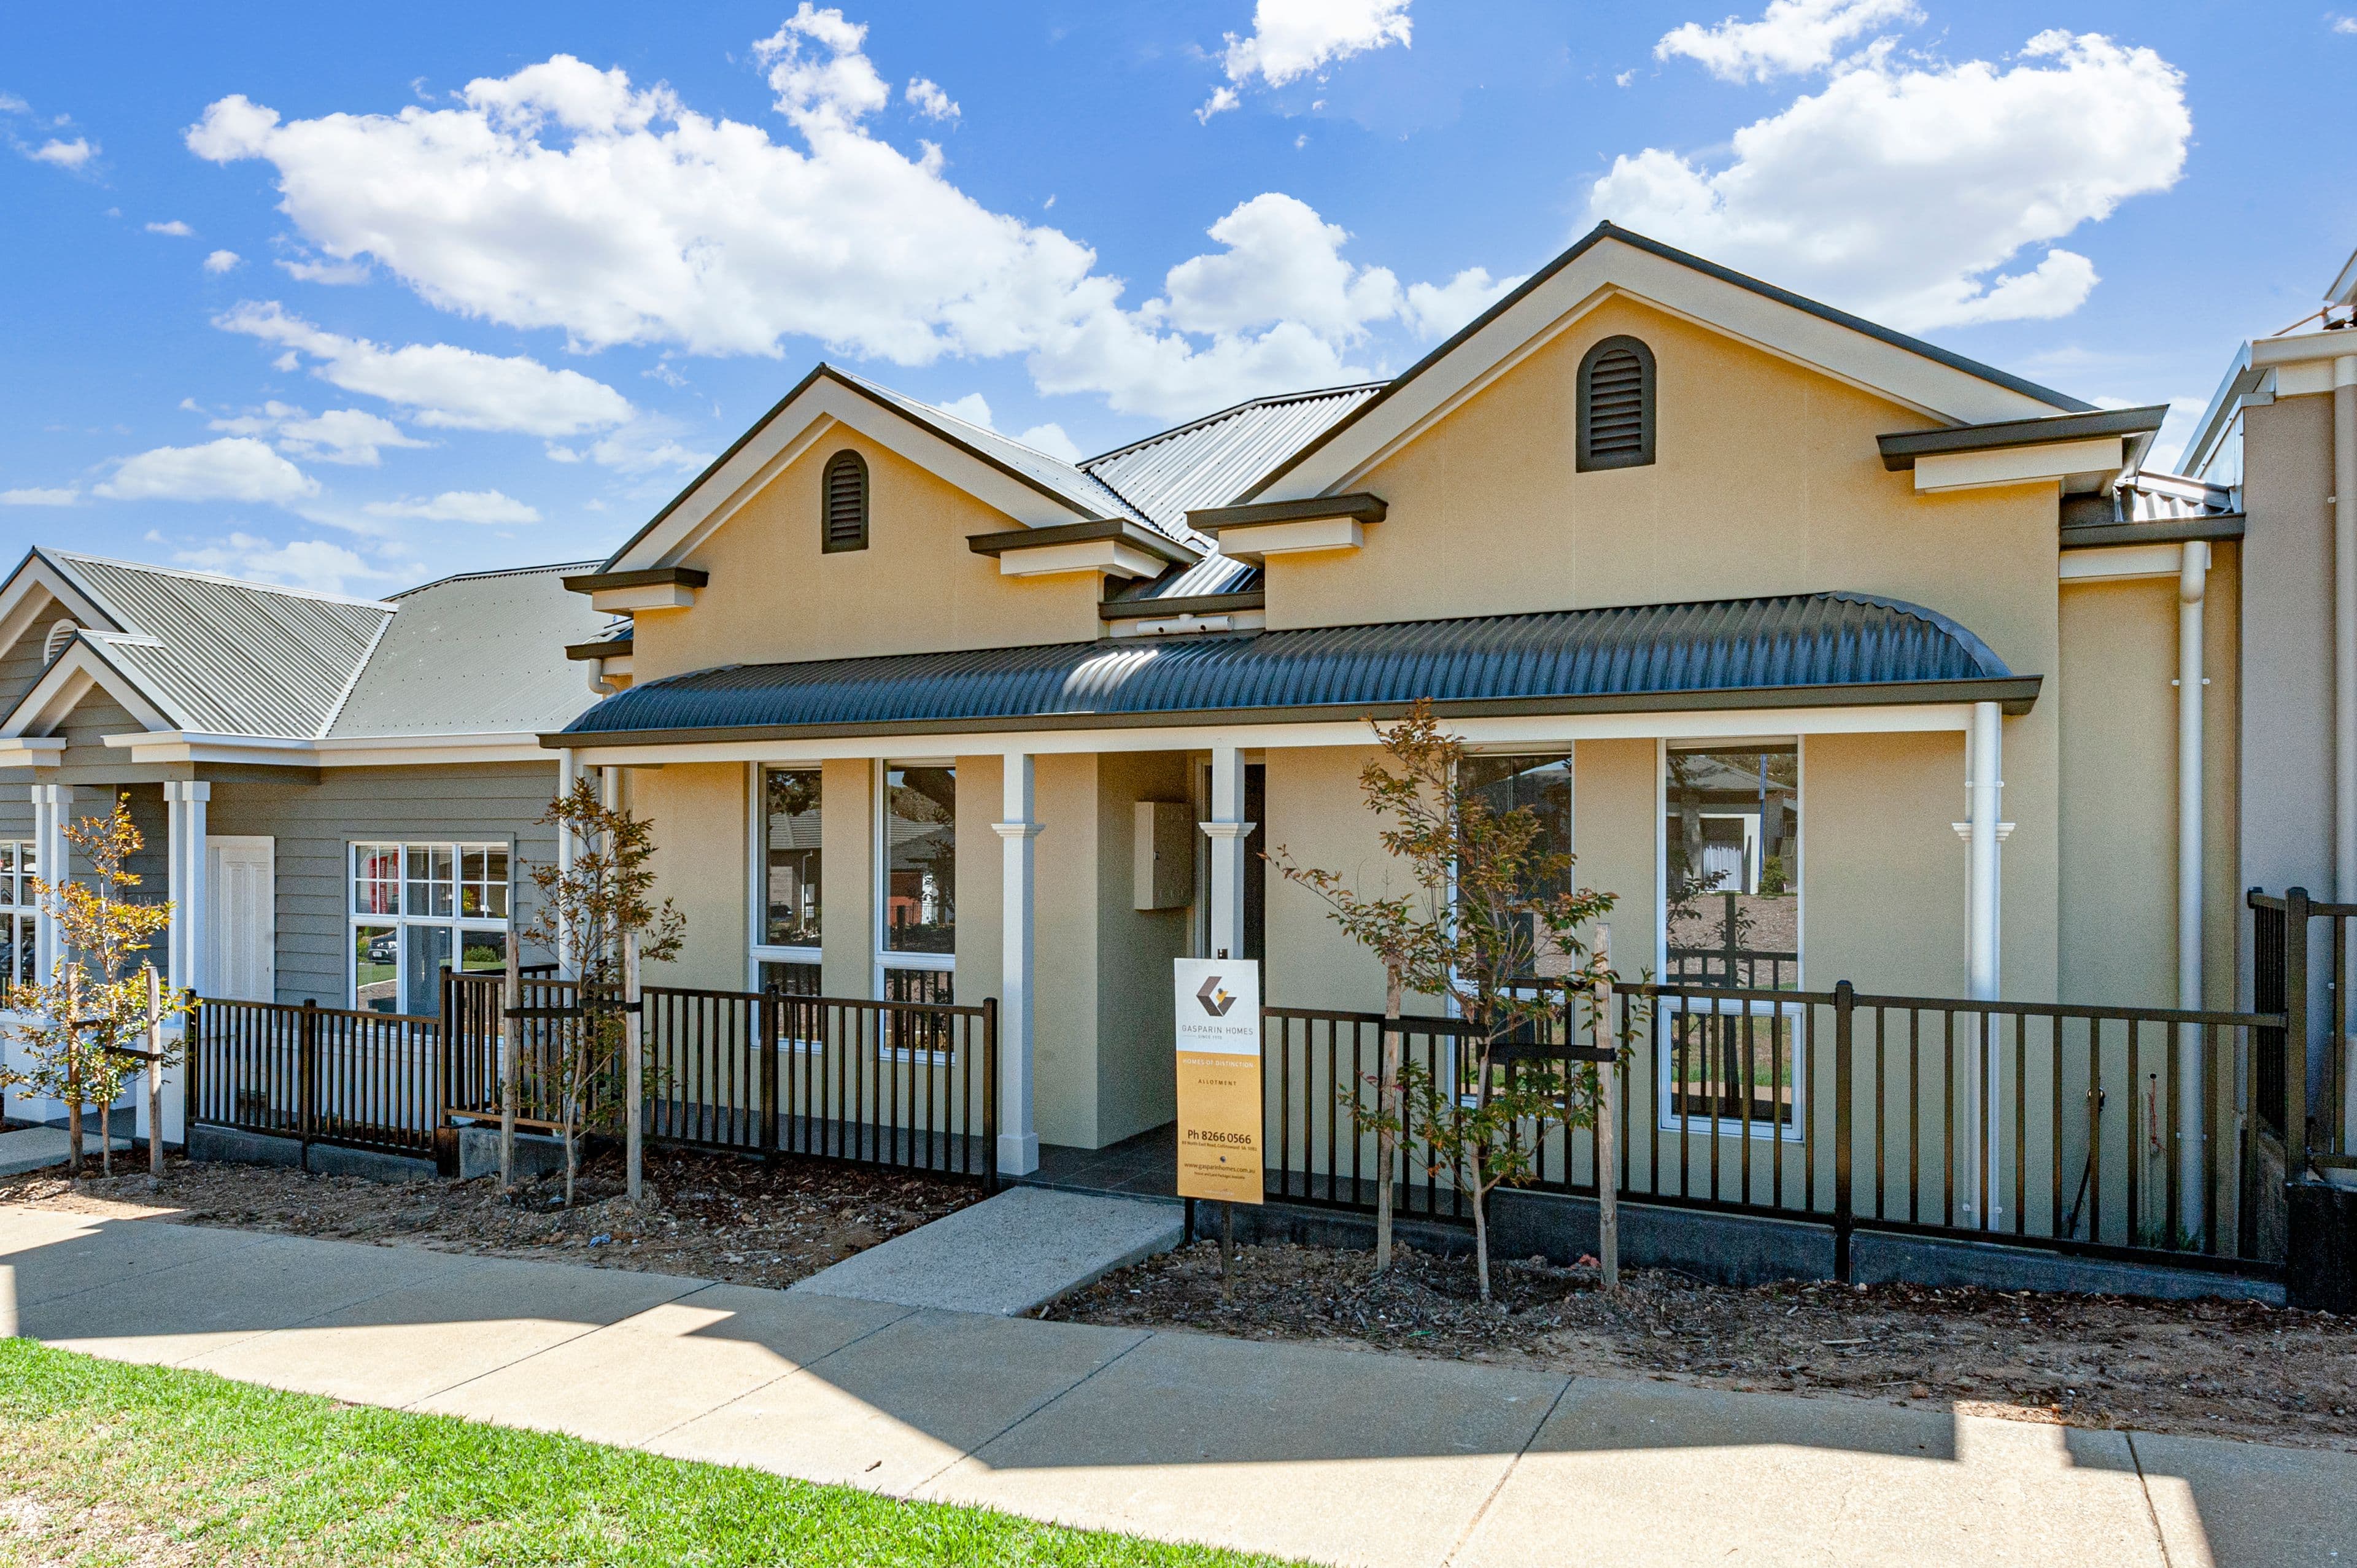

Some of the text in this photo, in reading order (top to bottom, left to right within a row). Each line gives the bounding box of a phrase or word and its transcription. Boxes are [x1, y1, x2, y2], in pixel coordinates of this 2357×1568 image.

[1182, 1025, 1253, 1035] GASPARIN HOMES
[1188, 1129, 1252, 1144] Ph 8266 0566
[1184, 1163, 1256, 1173] www.gasparinhomes.com.au
